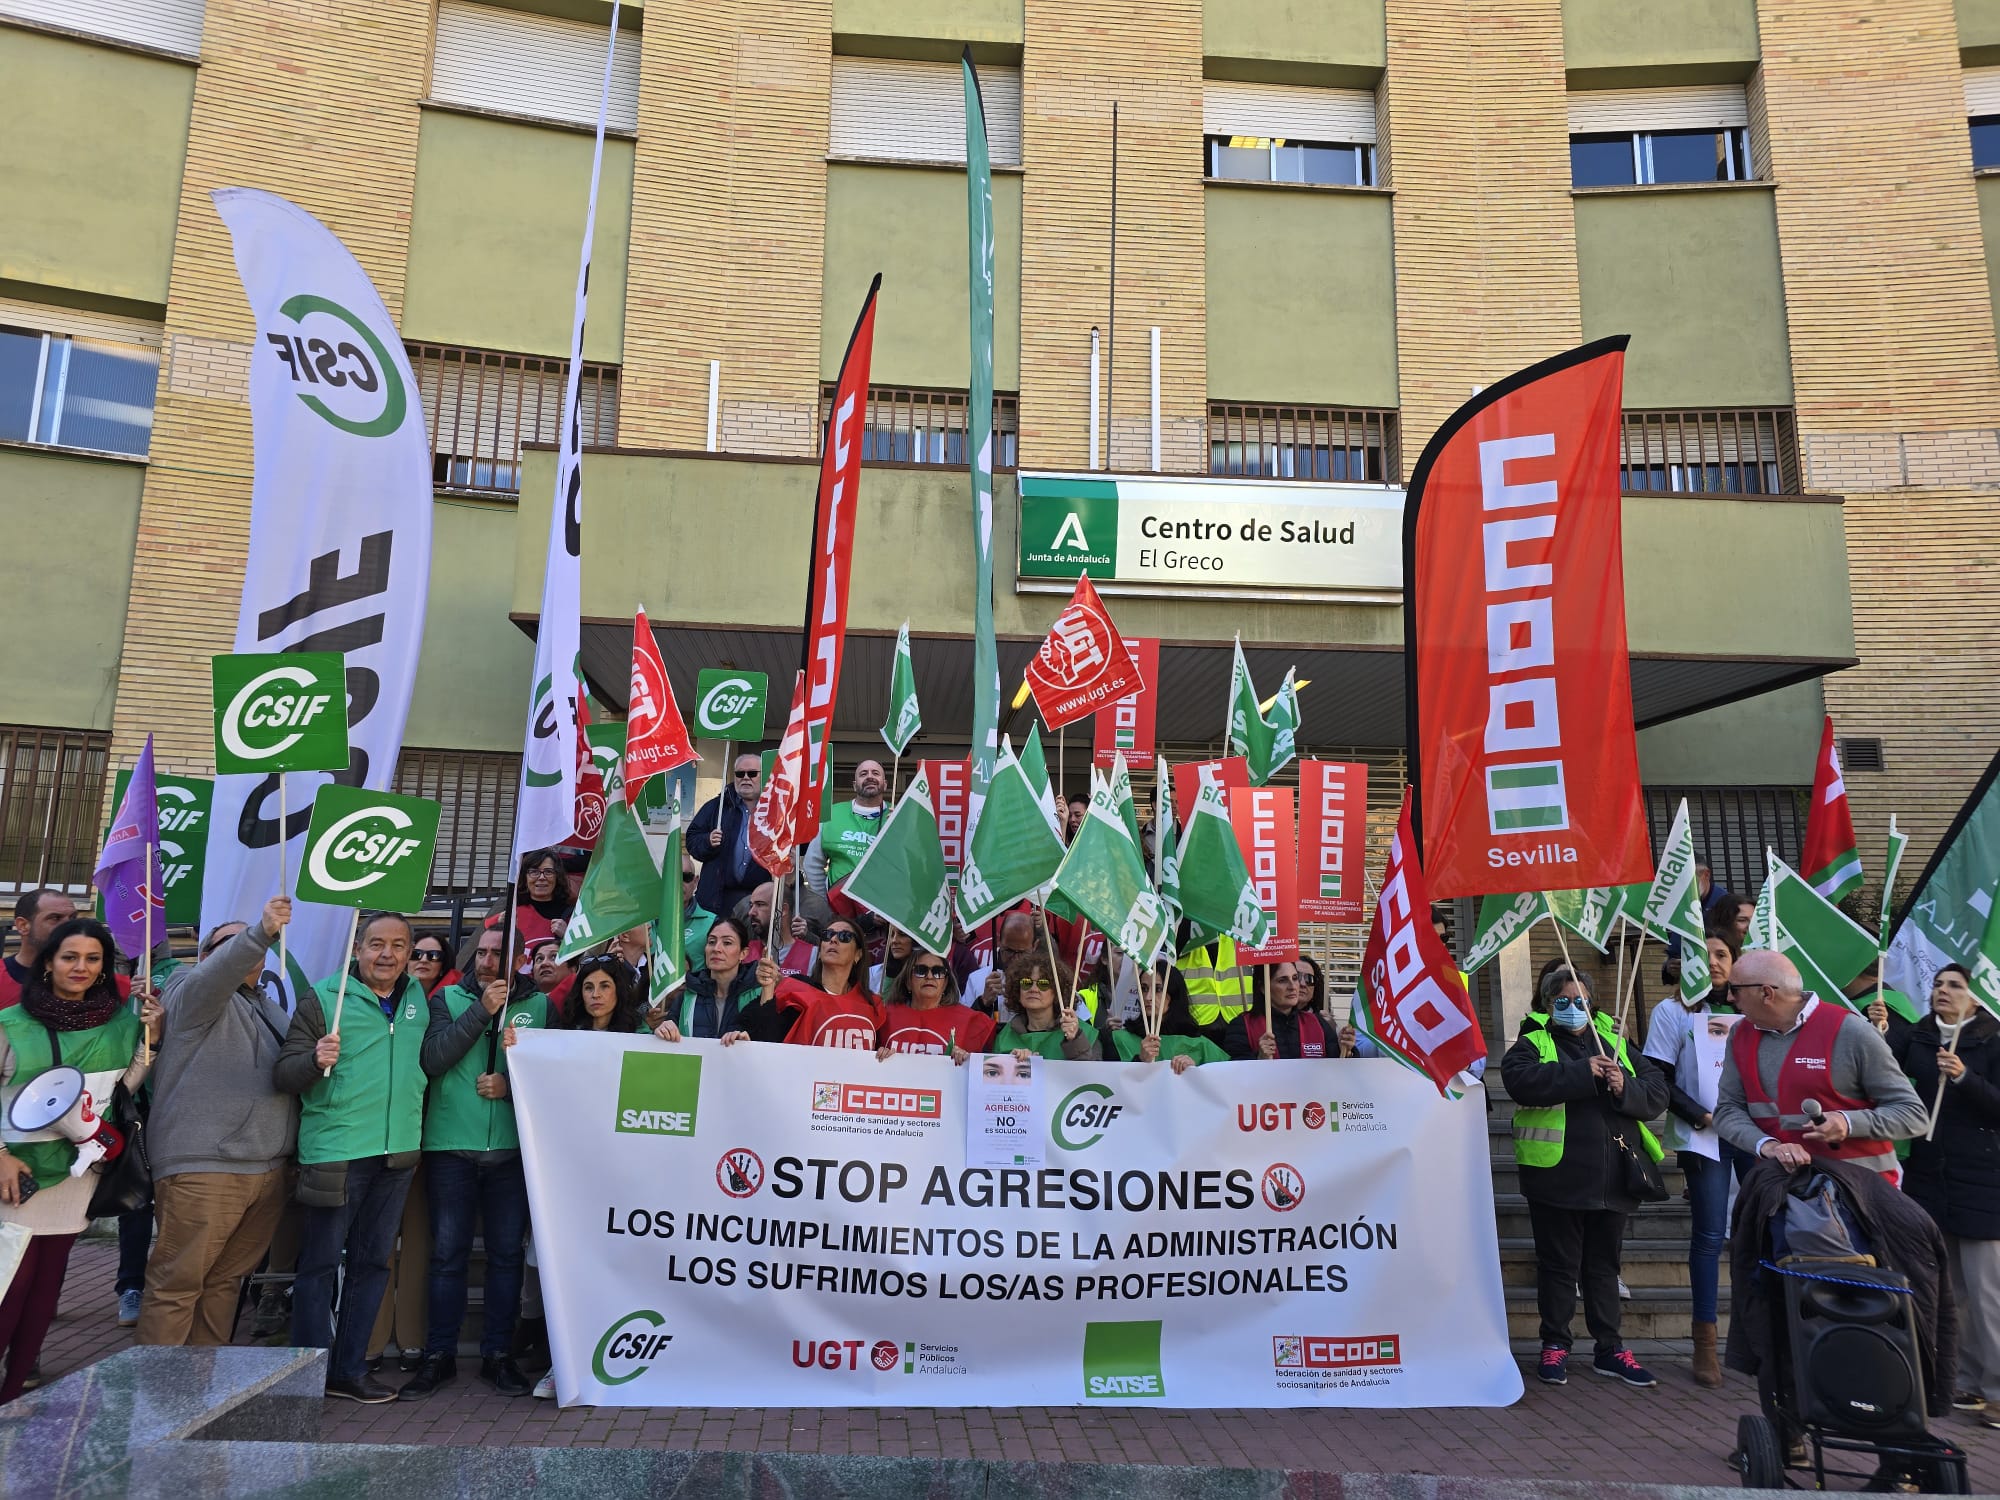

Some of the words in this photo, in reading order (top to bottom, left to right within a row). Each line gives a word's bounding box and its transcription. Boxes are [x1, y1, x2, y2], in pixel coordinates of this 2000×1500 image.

[1140, 516, 1233, 541] Centro
[1239, 518, 1272, 543] de
[1280, 520, 1356, 545] Salud
[1027, 552, 1053, 563] Junta
[1054, 553, 1065, 563] de
[1066, 553, 1110, 565] Andalucía
[1139, 549, 1157, 568] El
[1164, 550, 1224, 571] Greco
[1479, 433, 1561, 753] CCOO
[629, 664, 658, 721] GT
[1056, 677, 1126, 714] www.ugt.es
[243, 693, 331, 728] CSIF
[711, 694, 758, 715] CSIF
[158, 806, 205, 832] SIF
[1320, 765, 1346, 871] CCOO
[332, 824, 421, 867] CSIF
[841, 830, 876, 846] SATS
[1252, 791, 1277, 907] CCOO
[1487, 843, 1578, 868] Sevilla
[848, 1089, 918, 1112] CCOO
[985, 1104, 1030, 1113] AGRESIÓN
[1342, 1101, 1375, 1109] Servicios
[621, 1109, 691, 1133] SATSE
[812, 1112, 854, 1123] federación
[868, 1116, 899, 1126] sanidad
[900, 1119, 905, 1127] y
[906, 1118, 941, 1128] sectores
[997, 1116, 1016, 1127] NO
[1065, 1104, 1122, 1129] CSIF
[1237, 1103, 1297, 1132] UGT
[1342, 1111, 1374, 1120] Públicos
[1344, 1122, 1388, 1132] Andalucía
[810, 1123, 871, 1134] sociosanitarios
[873, 1127, 884, 1135] de
[885, 1128, 924, 1138] Andalucía
[771, 1156, 908, 1201] STOP
[921, 1169, 1255, 1213] AGRESIONES
[606, 1207, 675, 1238] LOS
[686, 1213, 1005, 1259] INCUMPLIMIENTOS
[1016, 1231, 1061, 1260] DE
[1073, 1232, 1115, 1260] LA
[1123, 1215, 1398, 1260] ADMINISTRACIÓN
[667, 1255, 736, 1287] LOS
[746, 1261, 928, 1299] SUFRIMOS
[939, 1272, 1064, 1301] LOS/AS
[1075, 1264, 1349, 1301] PROFESIONALES
[608, 1331, 673, 1360] CSIF
[792, 1340, 865, 1371] UGT
[919, 1343, 959, 1352] Servicios
[1310, 1342, 1377, 1361] CCOO
[919, 1353, 956, 1363] Públicos
[919, 1364, 967, 1375] Andalucía
[1275, 1368, 1320, 1378] federación
[1321, 1369, 1331, 1378] de
[1333, 1367, 1362, 1377] sanidad
[1363, 1368, 1368, 1376] y
[1369, 1366, 1403, 1375] sectores
[1276, 1380, 1337, 1389] sociosanitarios
[1339, 1380, 1349, 1388] de
[1350, 1377, 1390, 1388] Andalucía
[1089, 1373, 1159, 1395] SATSE
